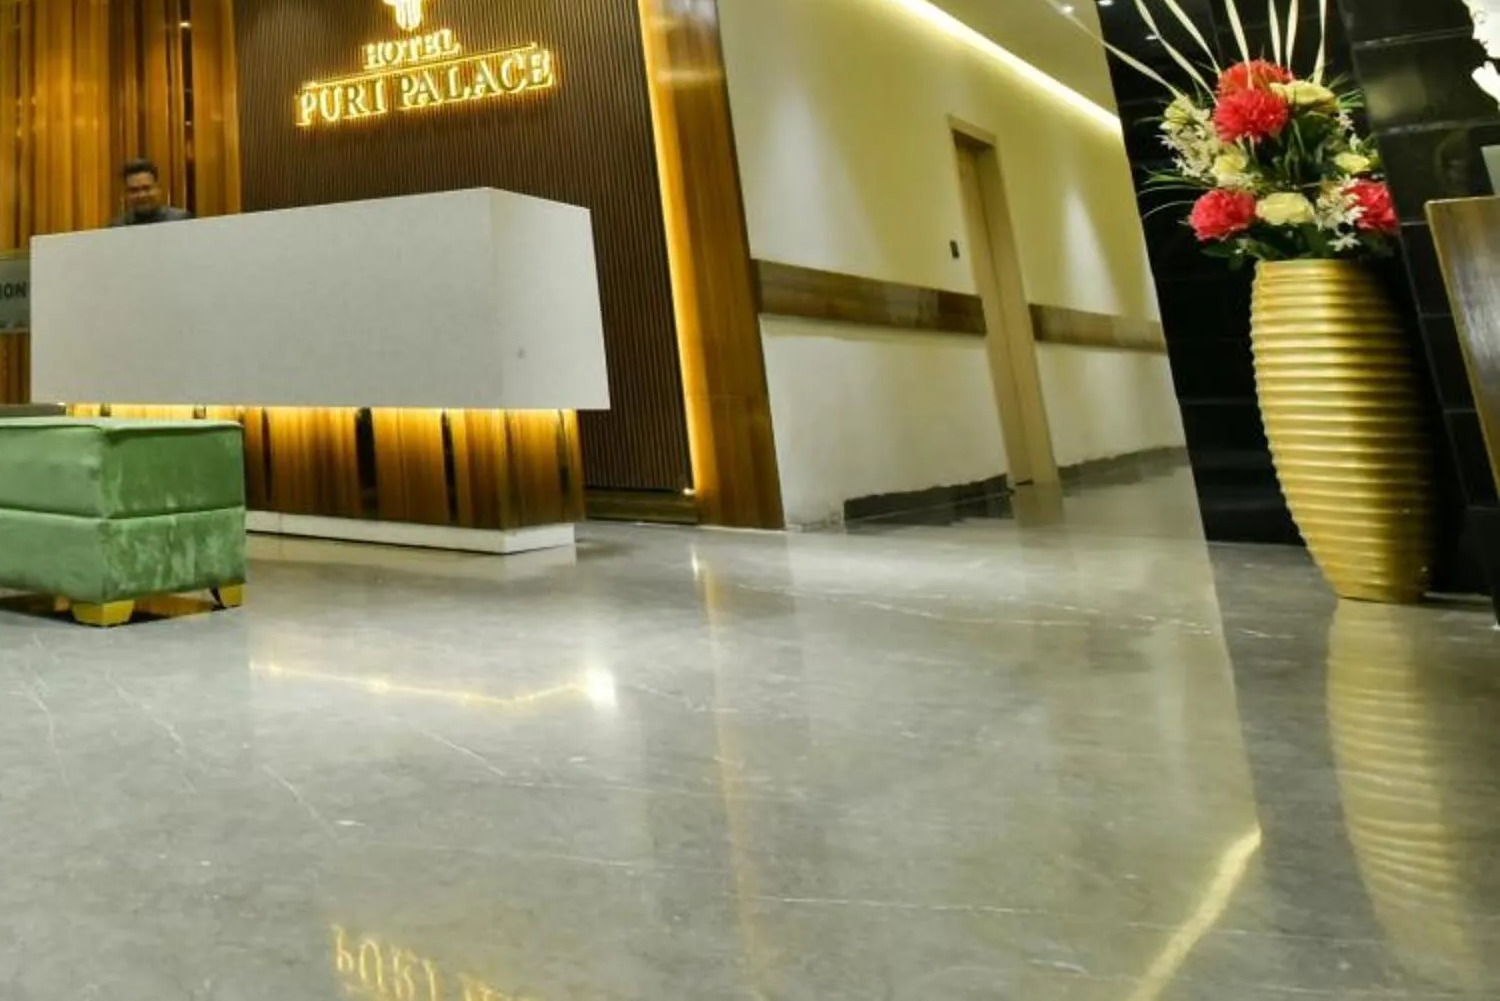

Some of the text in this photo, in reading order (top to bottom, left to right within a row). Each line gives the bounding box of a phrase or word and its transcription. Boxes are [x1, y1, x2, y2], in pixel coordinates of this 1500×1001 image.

[363, 28, 461, 70] HOTEL
[295, 48, 554, 127] PURI PALACE
